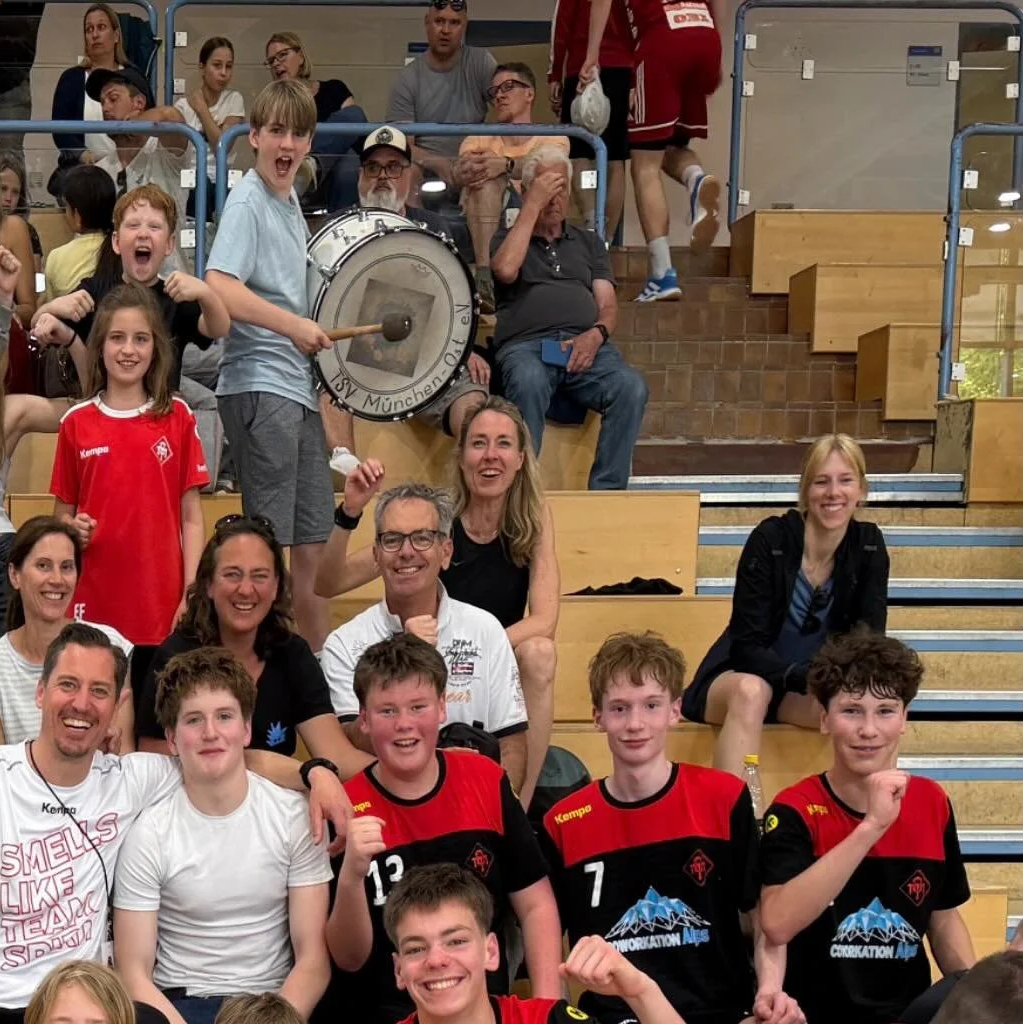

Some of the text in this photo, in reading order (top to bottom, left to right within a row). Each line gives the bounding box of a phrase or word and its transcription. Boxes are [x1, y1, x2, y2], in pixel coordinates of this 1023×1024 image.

[330, 367, 357, 400] TSV
[80, 445, 110, 459] Kempa
[554, 804, 593, 825] Kempa
[0, 812, 119, 878] SMELLS
[583, 860, 605, 909] 7
